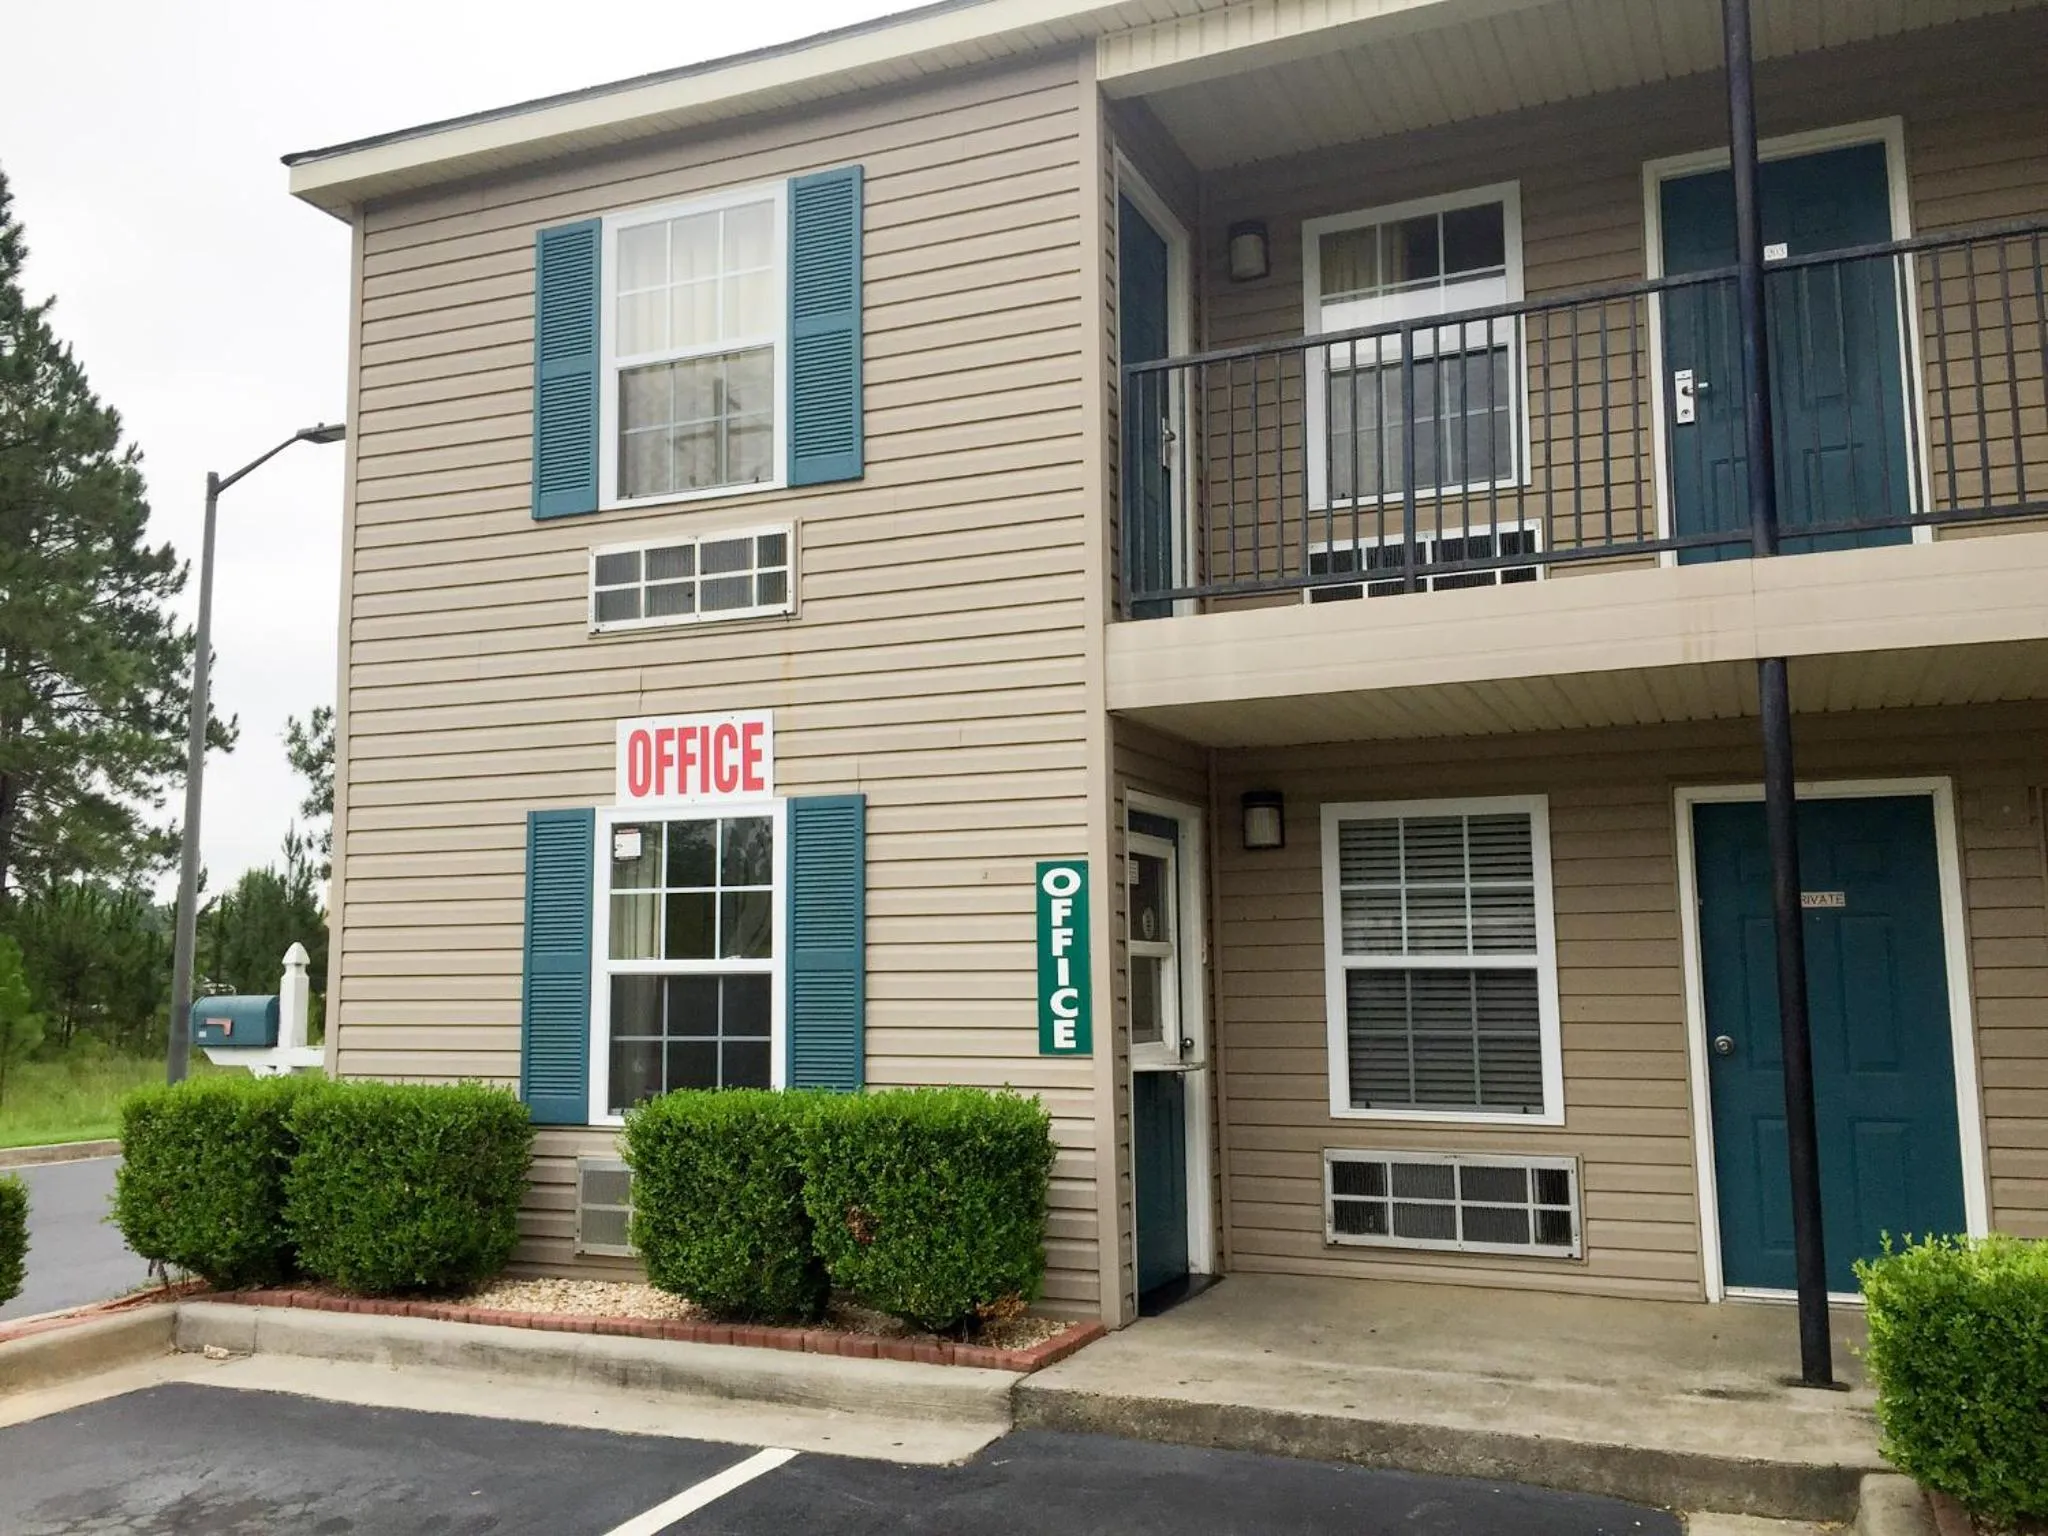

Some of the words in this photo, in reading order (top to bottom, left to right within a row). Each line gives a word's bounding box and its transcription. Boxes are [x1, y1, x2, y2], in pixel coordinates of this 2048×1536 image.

[628, 722, 764, 797] OFFICE
[1801, 893, 1843, 905] RIVATE
[1042, 867, 1081, 1048] OFFICE
